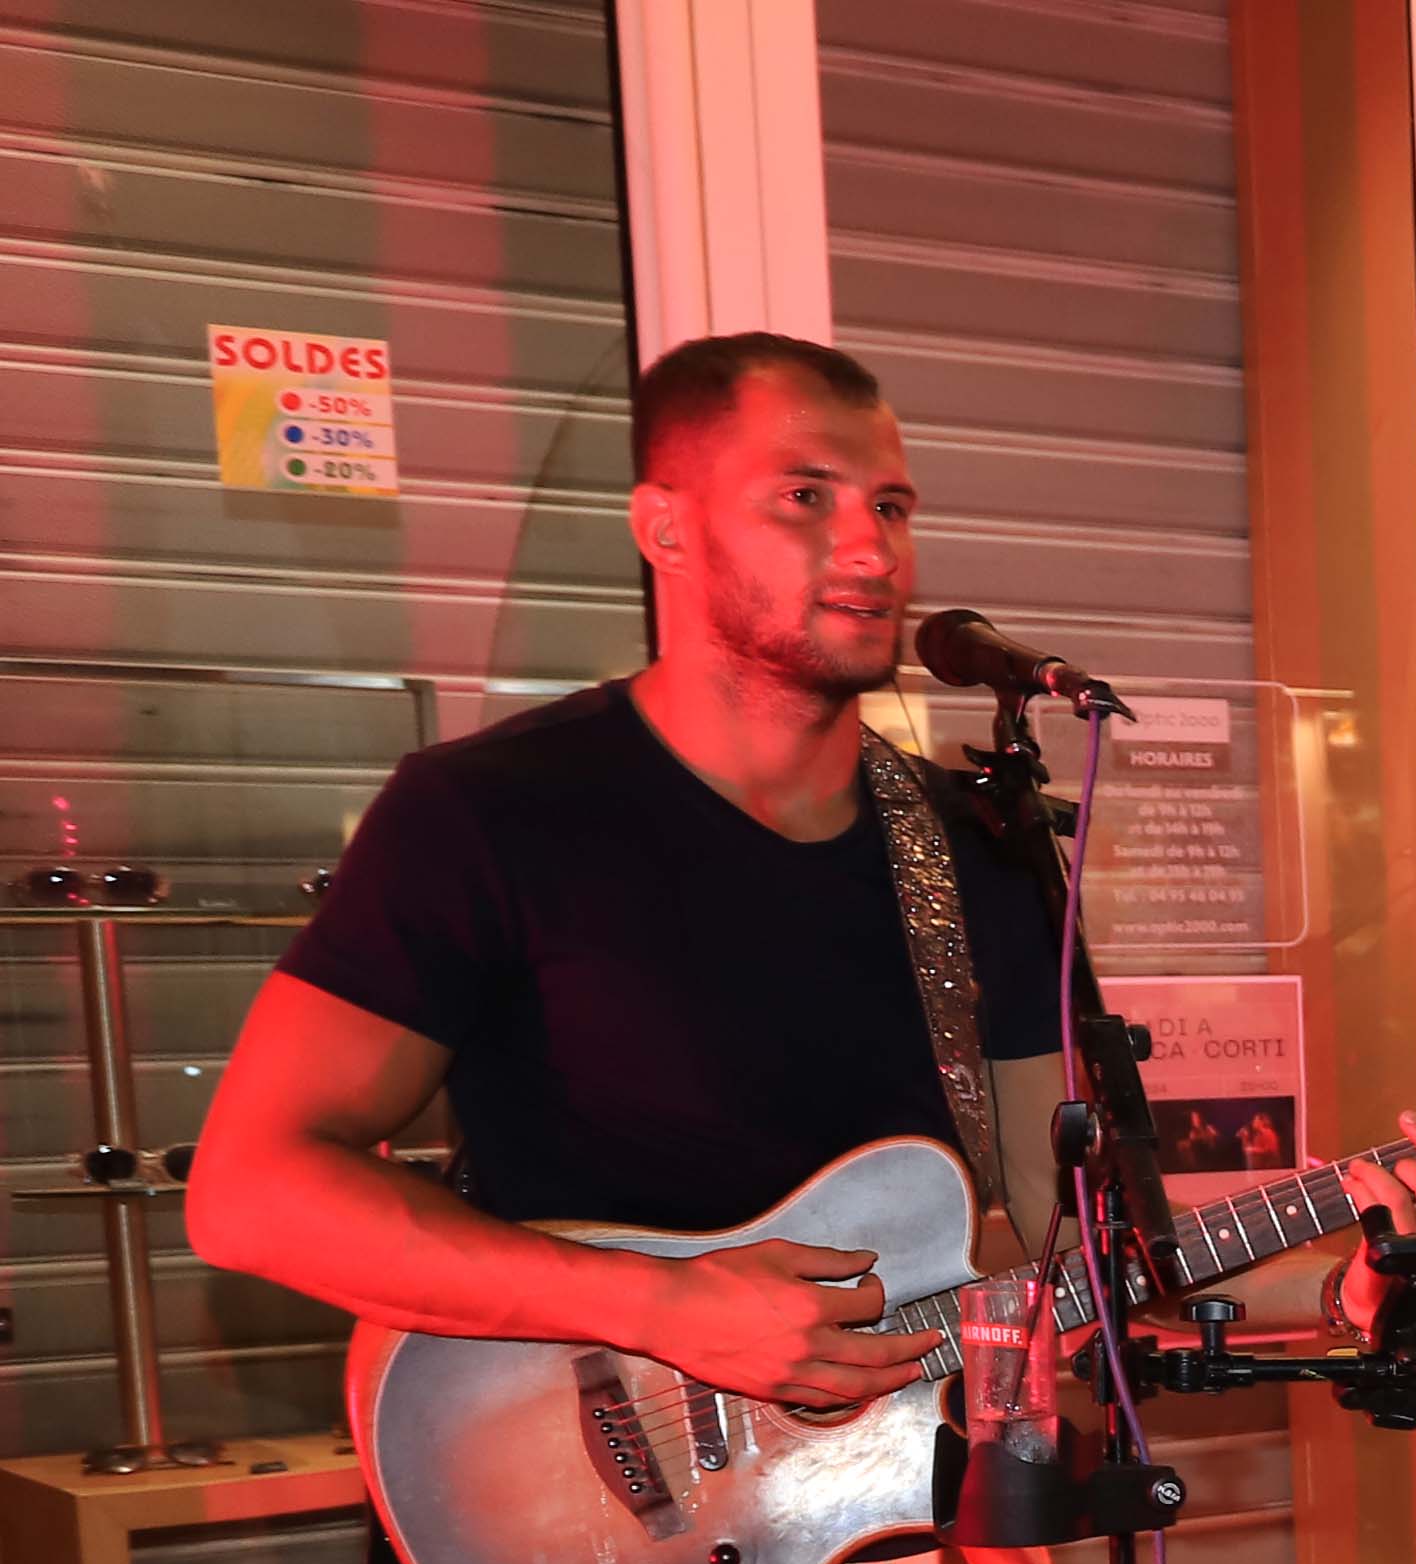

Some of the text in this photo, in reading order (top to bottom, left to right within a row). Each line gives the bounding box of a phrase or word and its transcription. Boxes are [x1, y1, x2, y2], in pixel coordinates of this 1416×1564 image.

[215, 334, 388, 380] SOLDES
[309, 395, 373, 418] -50%
[311, 427, 375, 449] -30%
[313, 460, 378, 481] -20%
[1130, 751, 1214, 768] HORAIRES
[1196, 1018, 1213, 1036] A
[1203, 1038, 1287, 1059] CORTI
